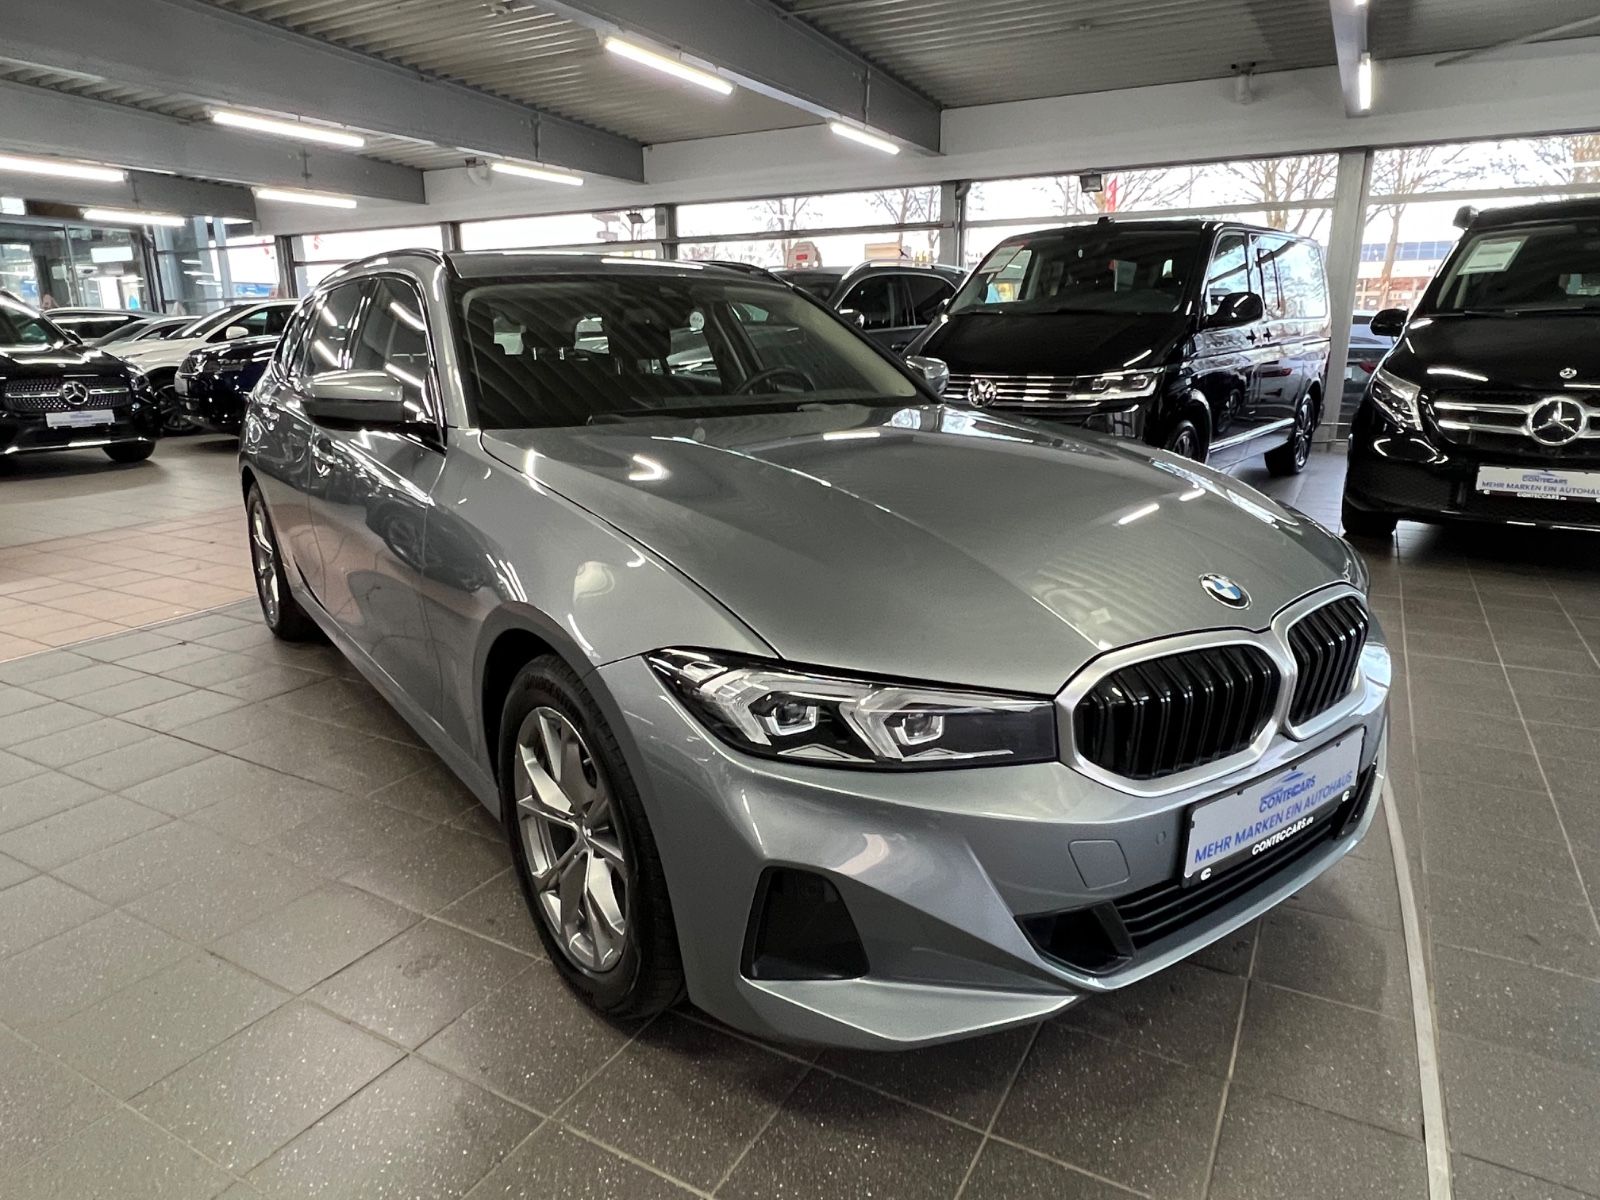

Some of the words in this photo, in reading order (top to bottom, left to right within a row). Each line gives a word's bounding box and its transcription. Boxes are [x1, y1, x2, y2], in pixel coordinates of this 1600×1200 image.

[1506, 483, 1541, 491] MARKEN
[1559, 486, 1600, 496] AUTOHAU
[1195, 835, 1232, 863] MEHR
[1234, 812, 1284, 846] MARKEN
[1285, 803, 1303, 820] EIN
[1304, 771, 1353, 811] AUTOHAUS
